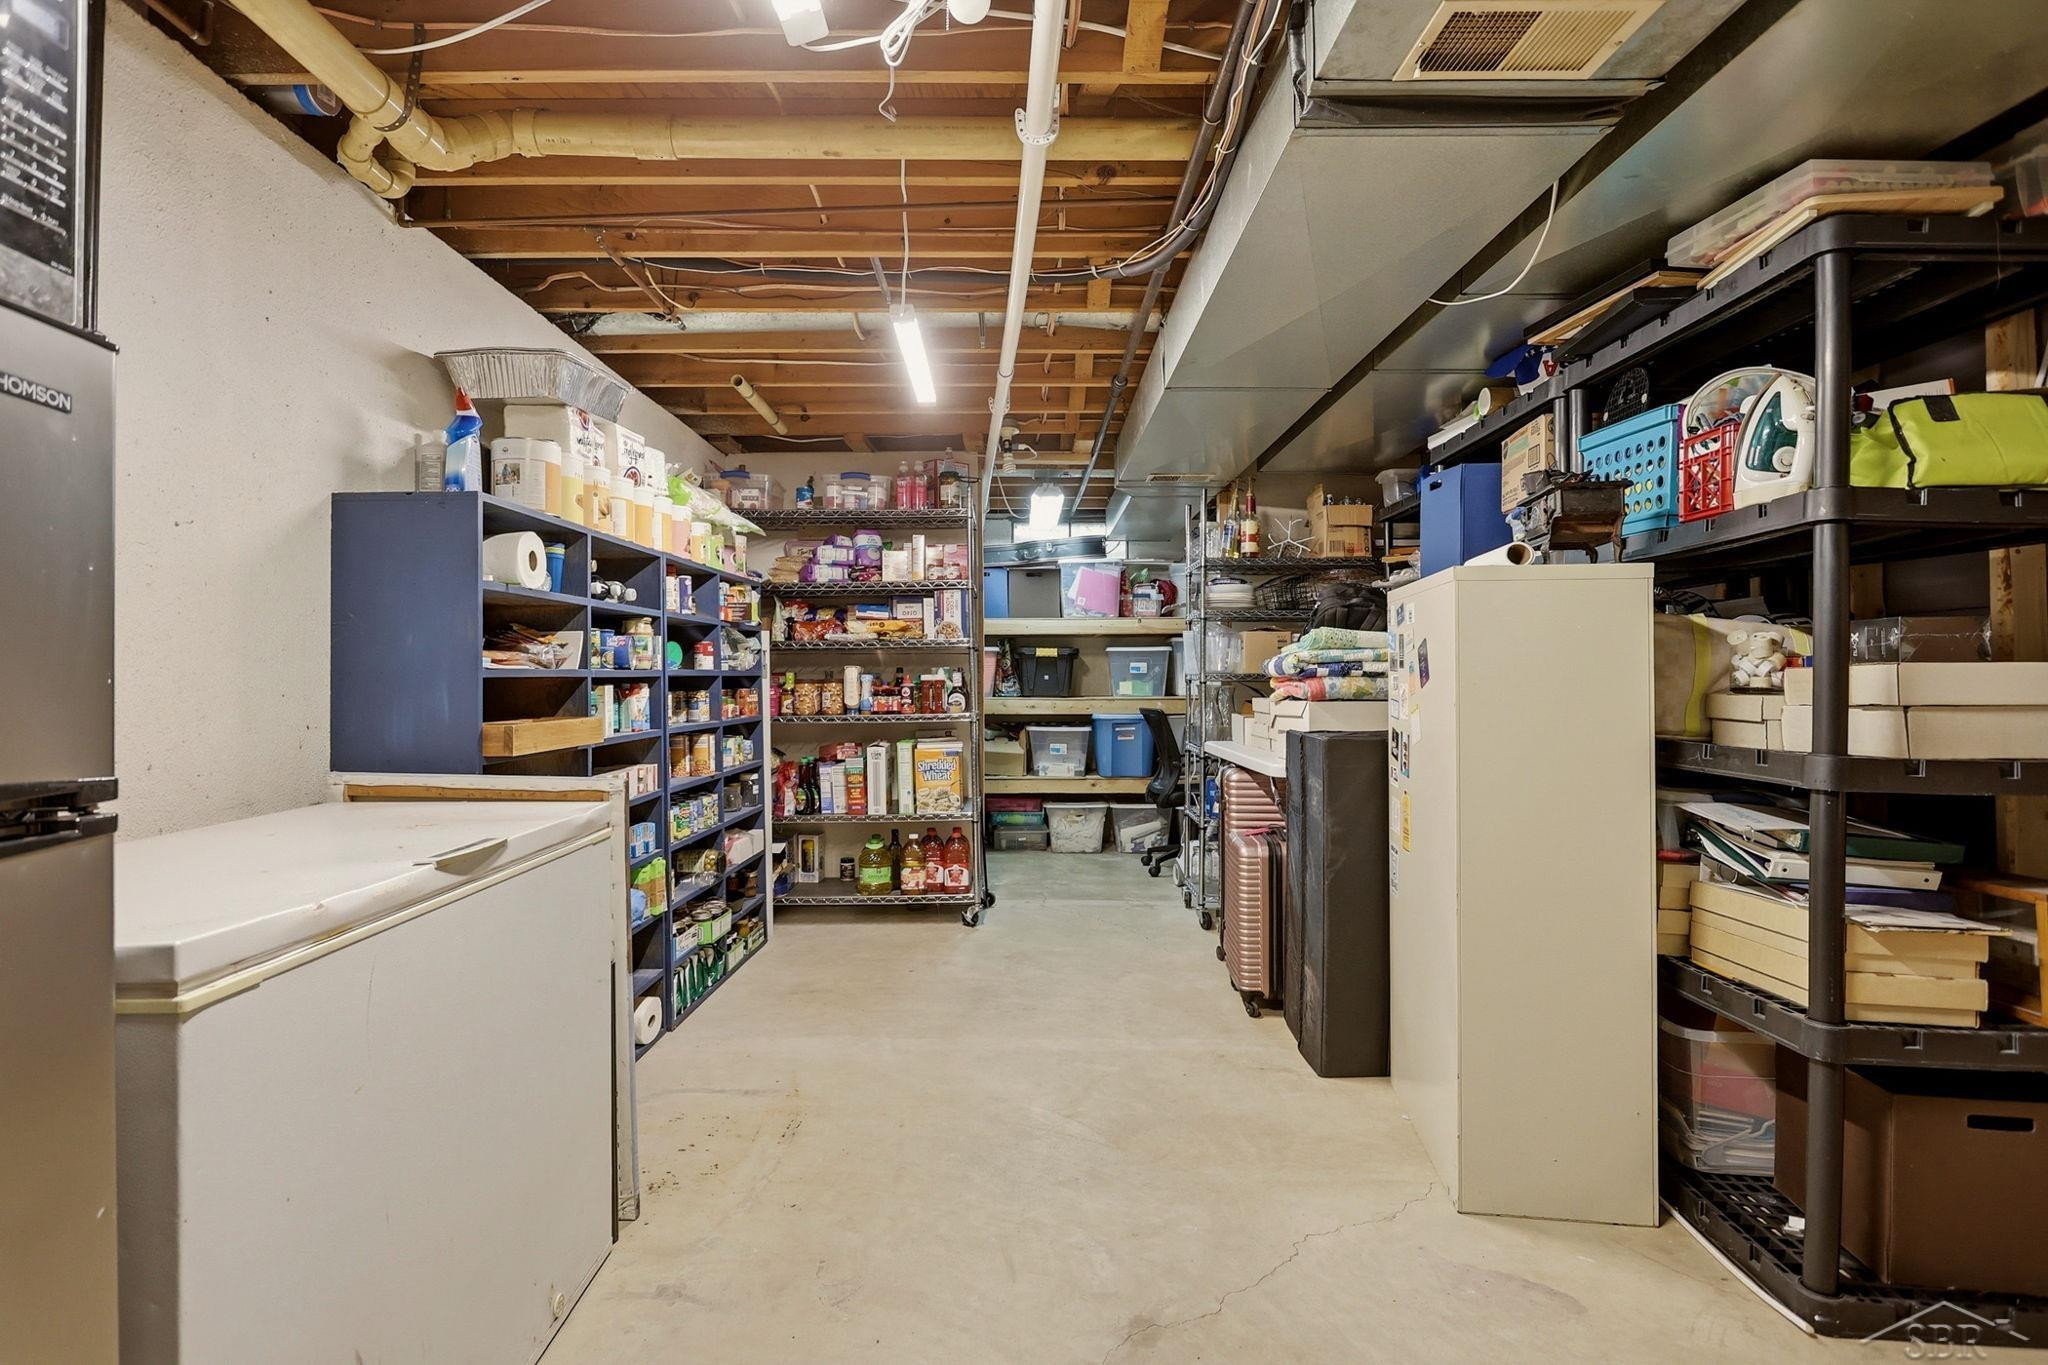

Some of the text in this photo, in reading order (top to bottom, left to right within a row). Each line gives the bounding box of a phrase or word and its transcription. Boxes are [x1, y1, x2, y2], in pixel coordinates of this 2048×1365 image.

[0, 374, 71, 410] HOMSON
[917, 757, 957, 772] Shredded
[922, 769, 952, 782] Wheat
